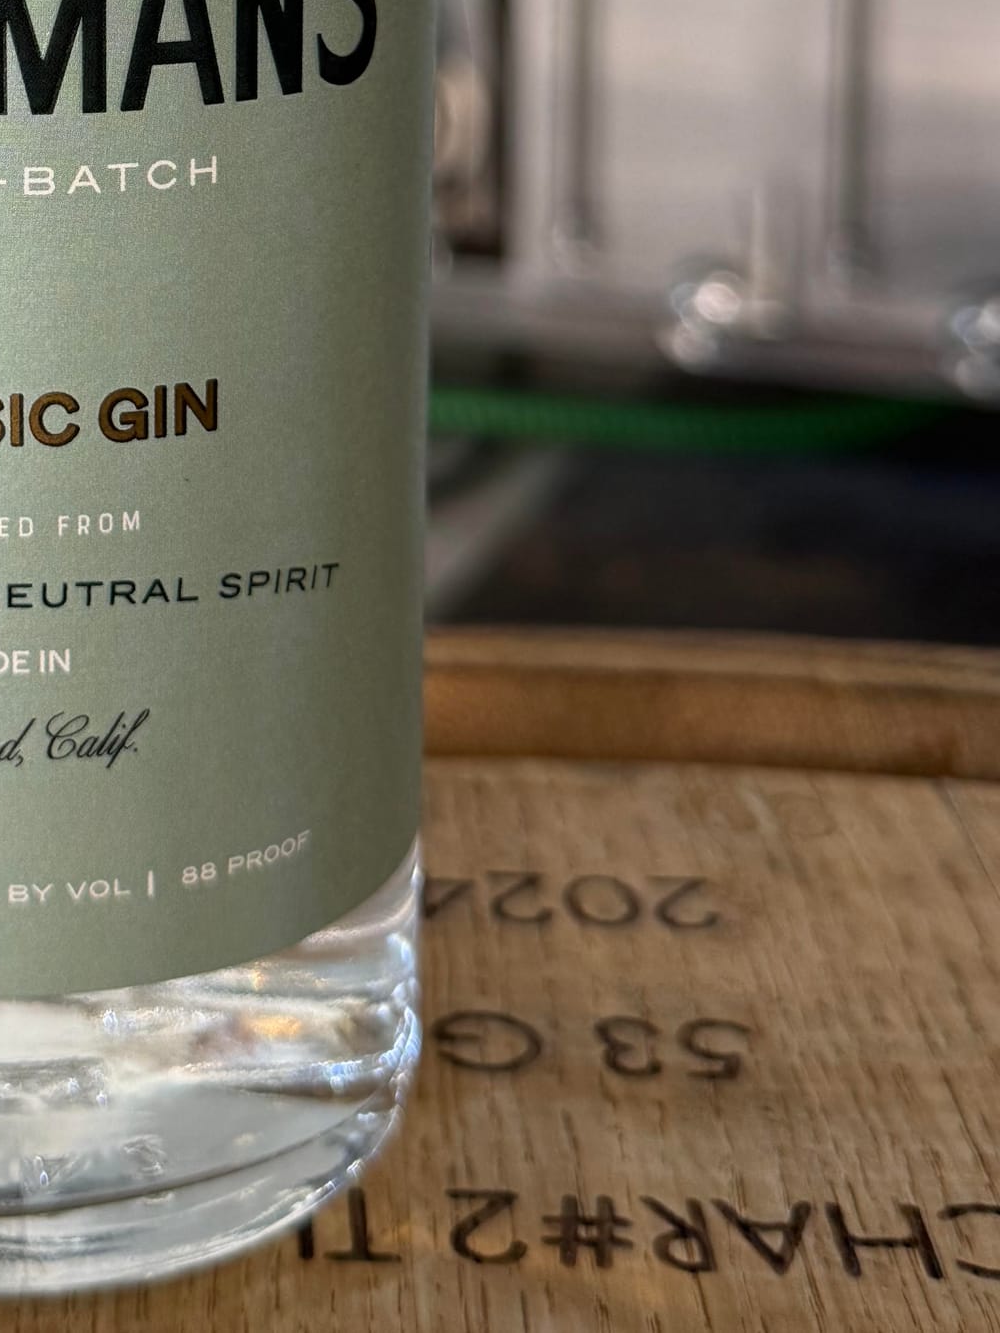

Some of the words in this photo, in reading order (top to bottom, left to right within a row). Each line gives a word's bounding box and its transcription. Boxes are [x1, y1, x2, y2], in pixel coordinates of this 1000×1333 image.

[98, 378, 219, 443] GIN
[56, 510, 142, 536] FROM
[218, 562, 340, 601] SPIRIT
[39, 648, 72, 674] IN
[44, 707, 151, 769] Calif.
[8, 883, 54, 904] BY
[66, 878, 131, 900] VOL
[181, 862, 218, 886] 88
[227, 829, 311, 877] PROOF
